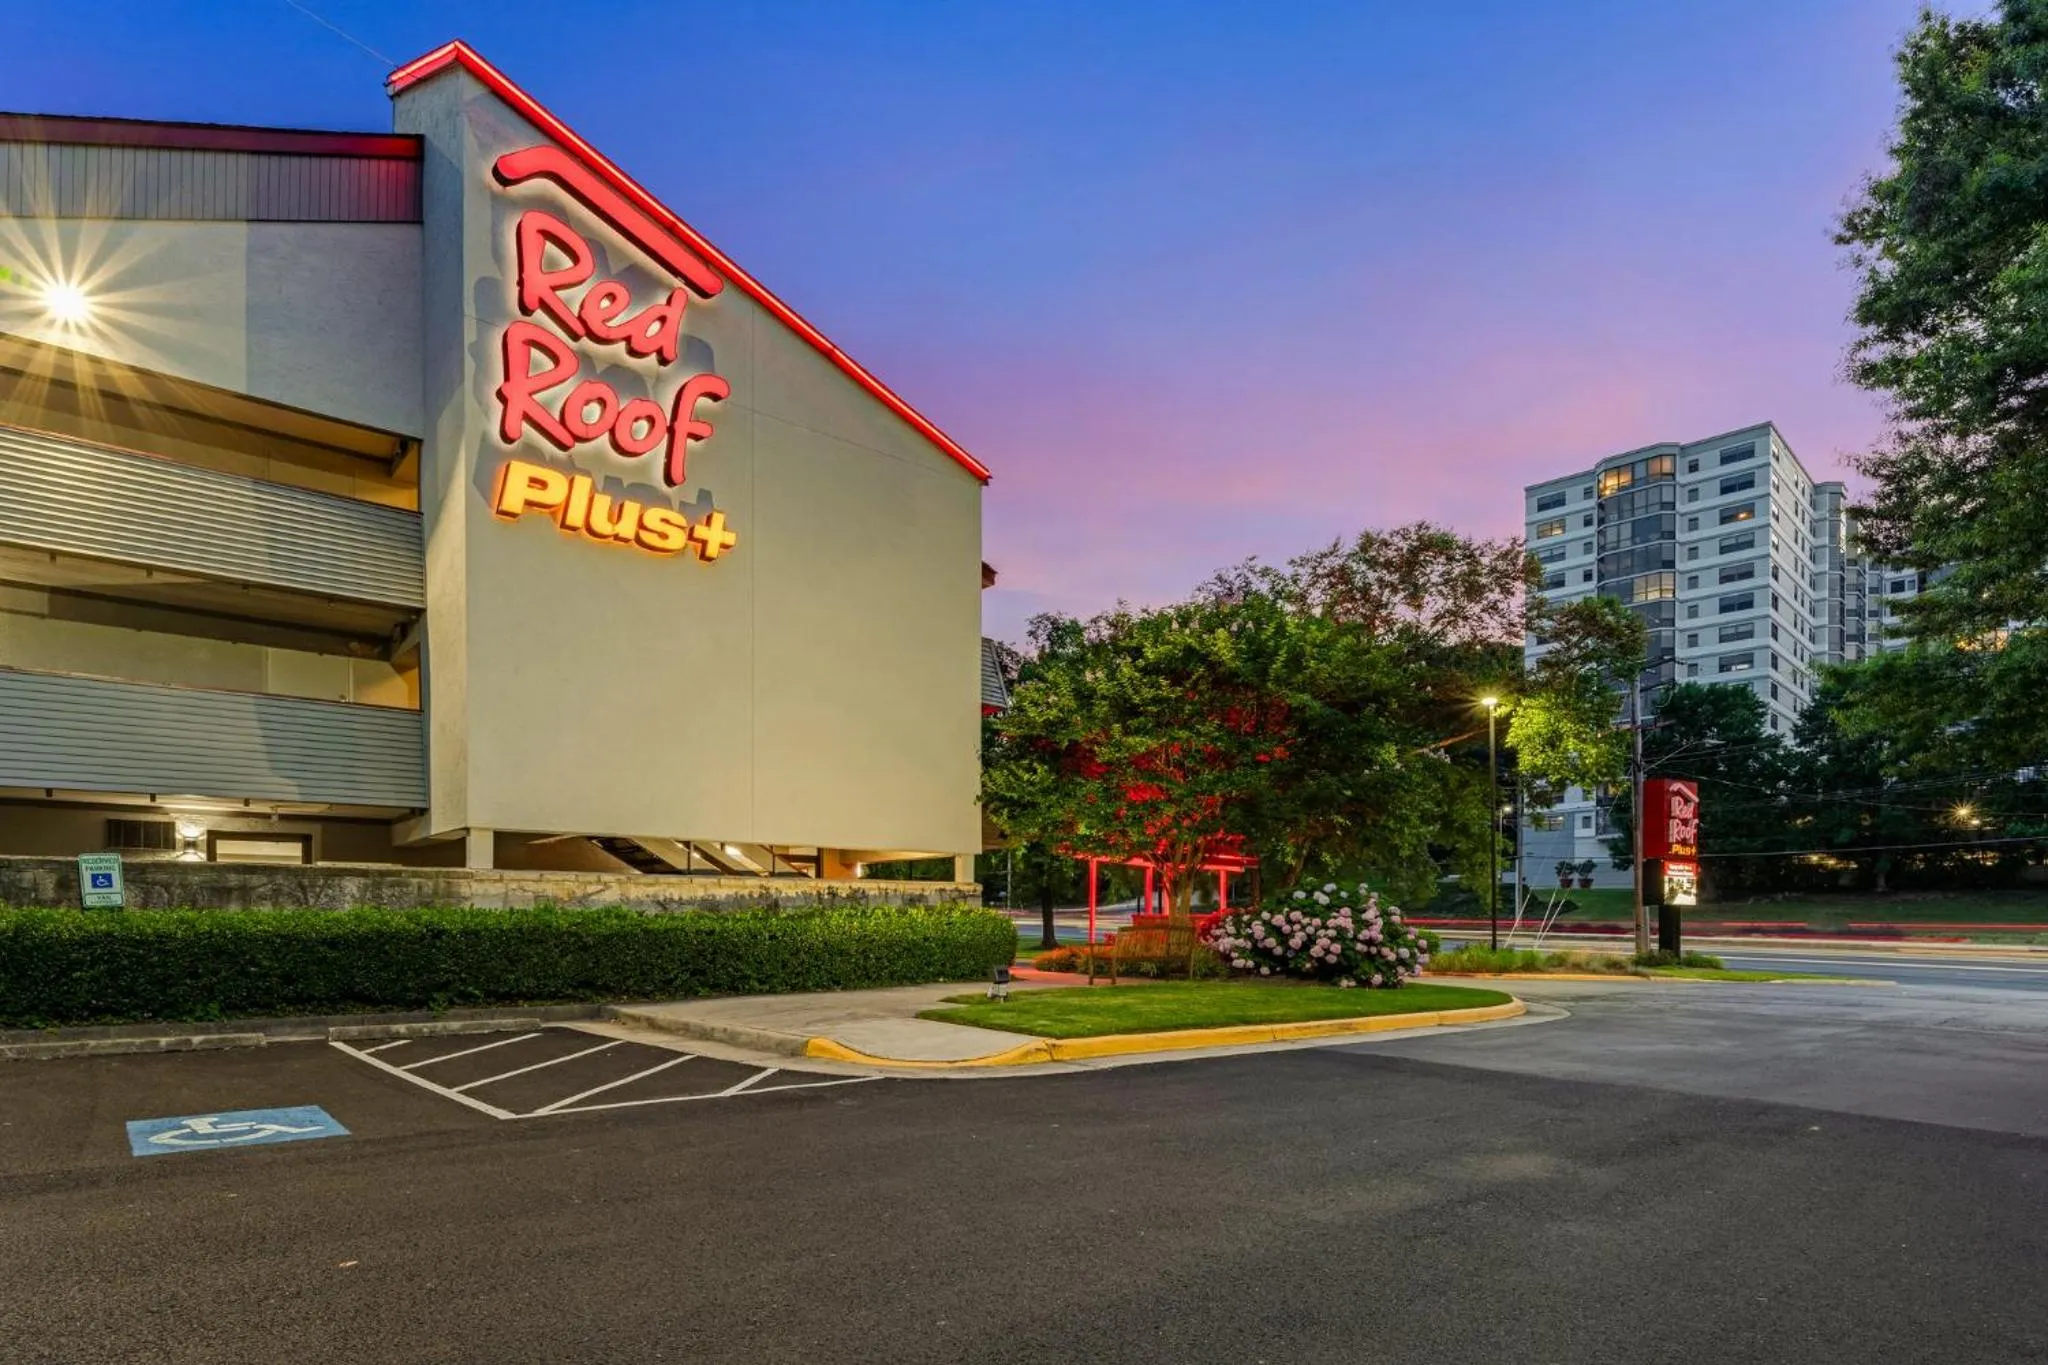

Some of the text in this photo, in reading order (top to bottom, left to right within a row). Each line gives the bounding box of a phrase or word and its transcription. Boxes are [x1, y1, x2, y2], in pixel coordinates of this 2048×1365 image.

[516, 210, 688, 367] Red
[496, 320, 731, 487] Roof
[496, 460, 737, 562] Plus+
[1669, 819, 1699, 844] Roof
[1671, 796, 1695, 819] Red
[1671, 844, 1697, 856] Plus+
